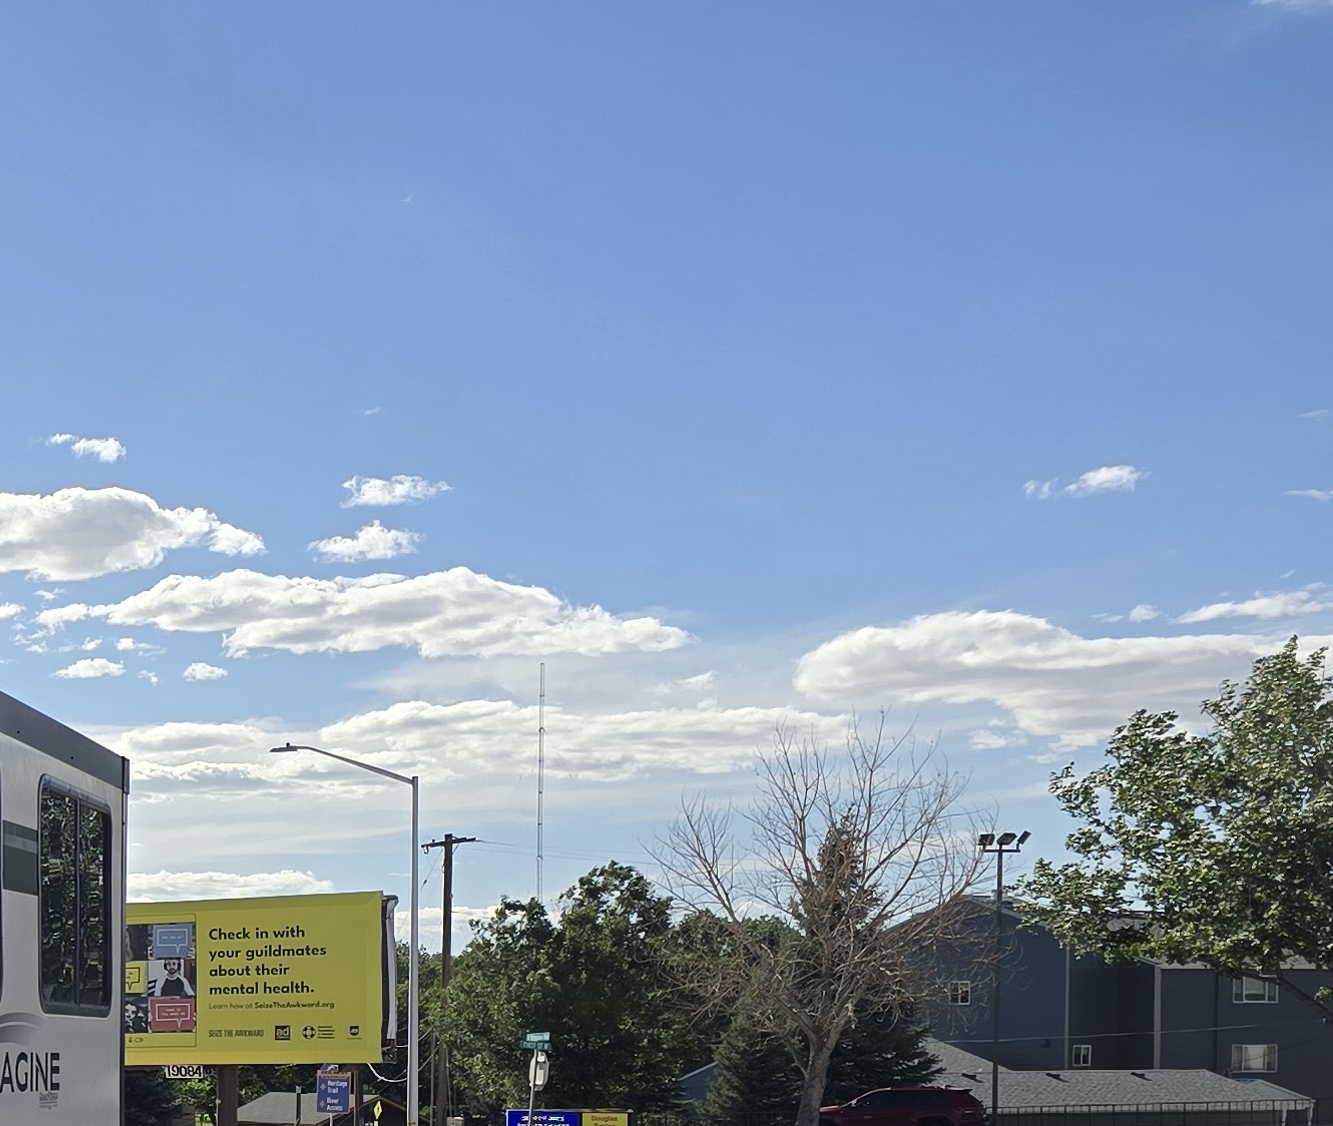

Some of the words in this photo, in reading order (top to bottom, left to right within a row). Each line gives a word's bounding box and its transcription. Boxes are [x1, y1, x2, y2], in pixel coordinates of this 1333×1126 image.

[209, 927, 251, 941] Check
[255, 927, 269, 939] in
[273, 925, 305, 938] with
[209, 949, 242, 962] your
[245, 944, 327, 961] guildmates
[209, 964, 251, 977] about
[255, 963, 290, 976] their
[209, 981, 259, 995] mental
[263, 980, 315, 994] health.
[208, 1002, 228, 1010] Learn
[230, 1002, 244, 1010] how
[254, 1001, 335, 1010] SeizeTheAwkward.org
[208, 1029, 223, 1038] SEIZE
[224, 1029, 234, 1038] THE
[234, 1029, 265, 1038] AWKWARD
[276, 1026, 290, 1037] ad
[167, 1064, 202, 1078] 19084
